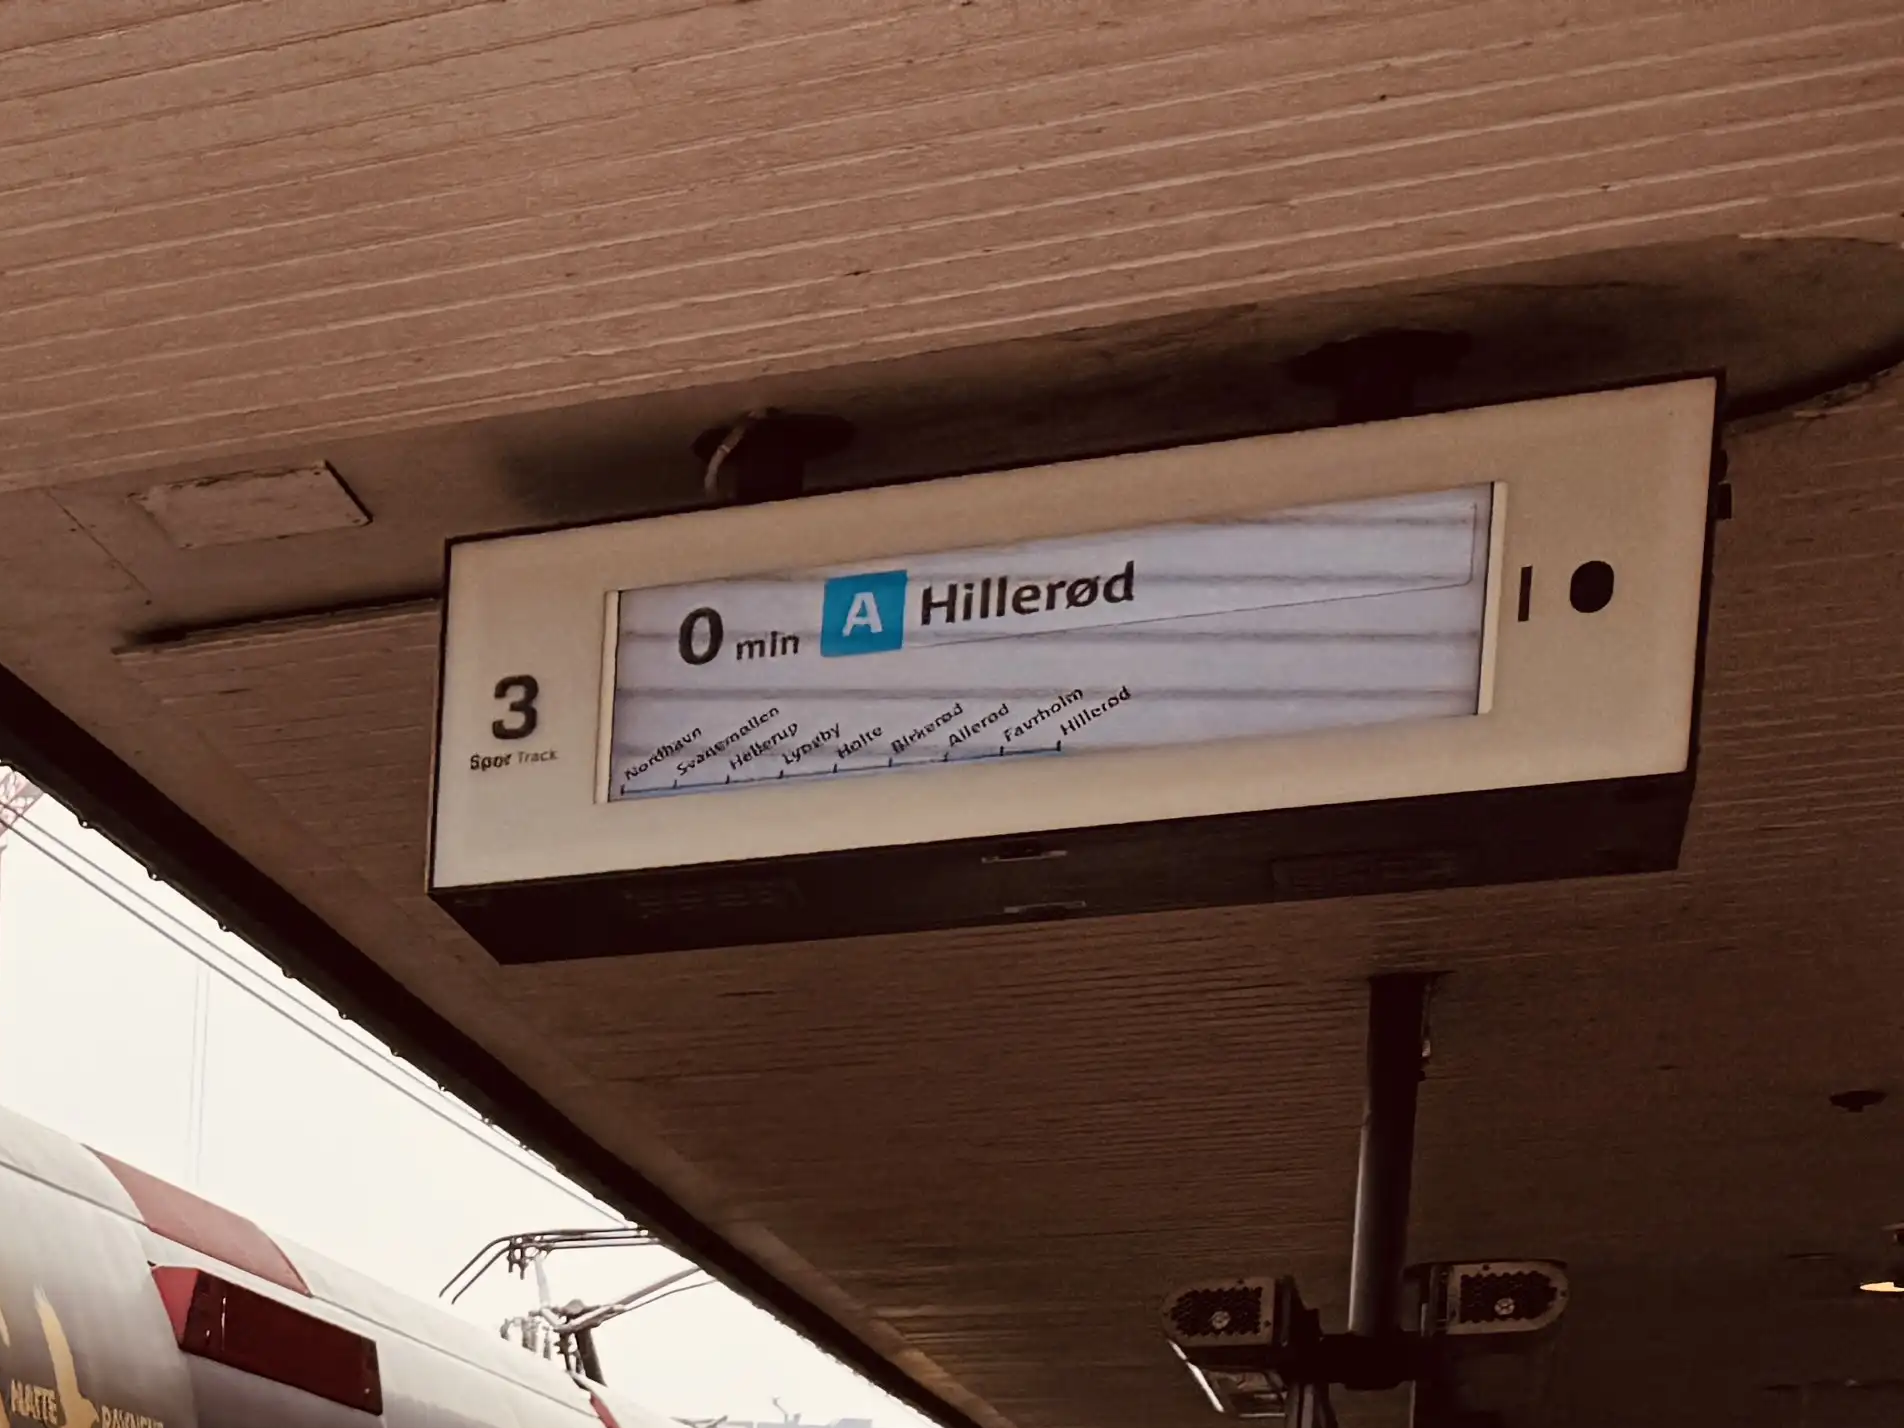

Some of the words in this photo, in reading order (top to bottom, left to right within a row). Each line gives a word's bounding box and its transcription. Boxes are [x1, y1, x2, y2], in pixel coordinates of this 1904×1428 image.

[678, 606, 724, 666] 0
[736, 629, 800, 662] min
[842, 591, 883, 638] A
[921, 560, 1135, 627] Hillerød
[491, 674, 539, 740] 3
[1004, 687, 1084, 743] Favrholm
[469, 752, 513, 772] Spor
[517, 747, 559, 765] Track
[624, 726, 703, 781] Nordhavn
[729, 721, 799, 771] Hellerup
[782, 722, 842, 766] Lyngby
[835, 724, 884, 761] Holte
[10, 1378, 58, 1426] NATTE
